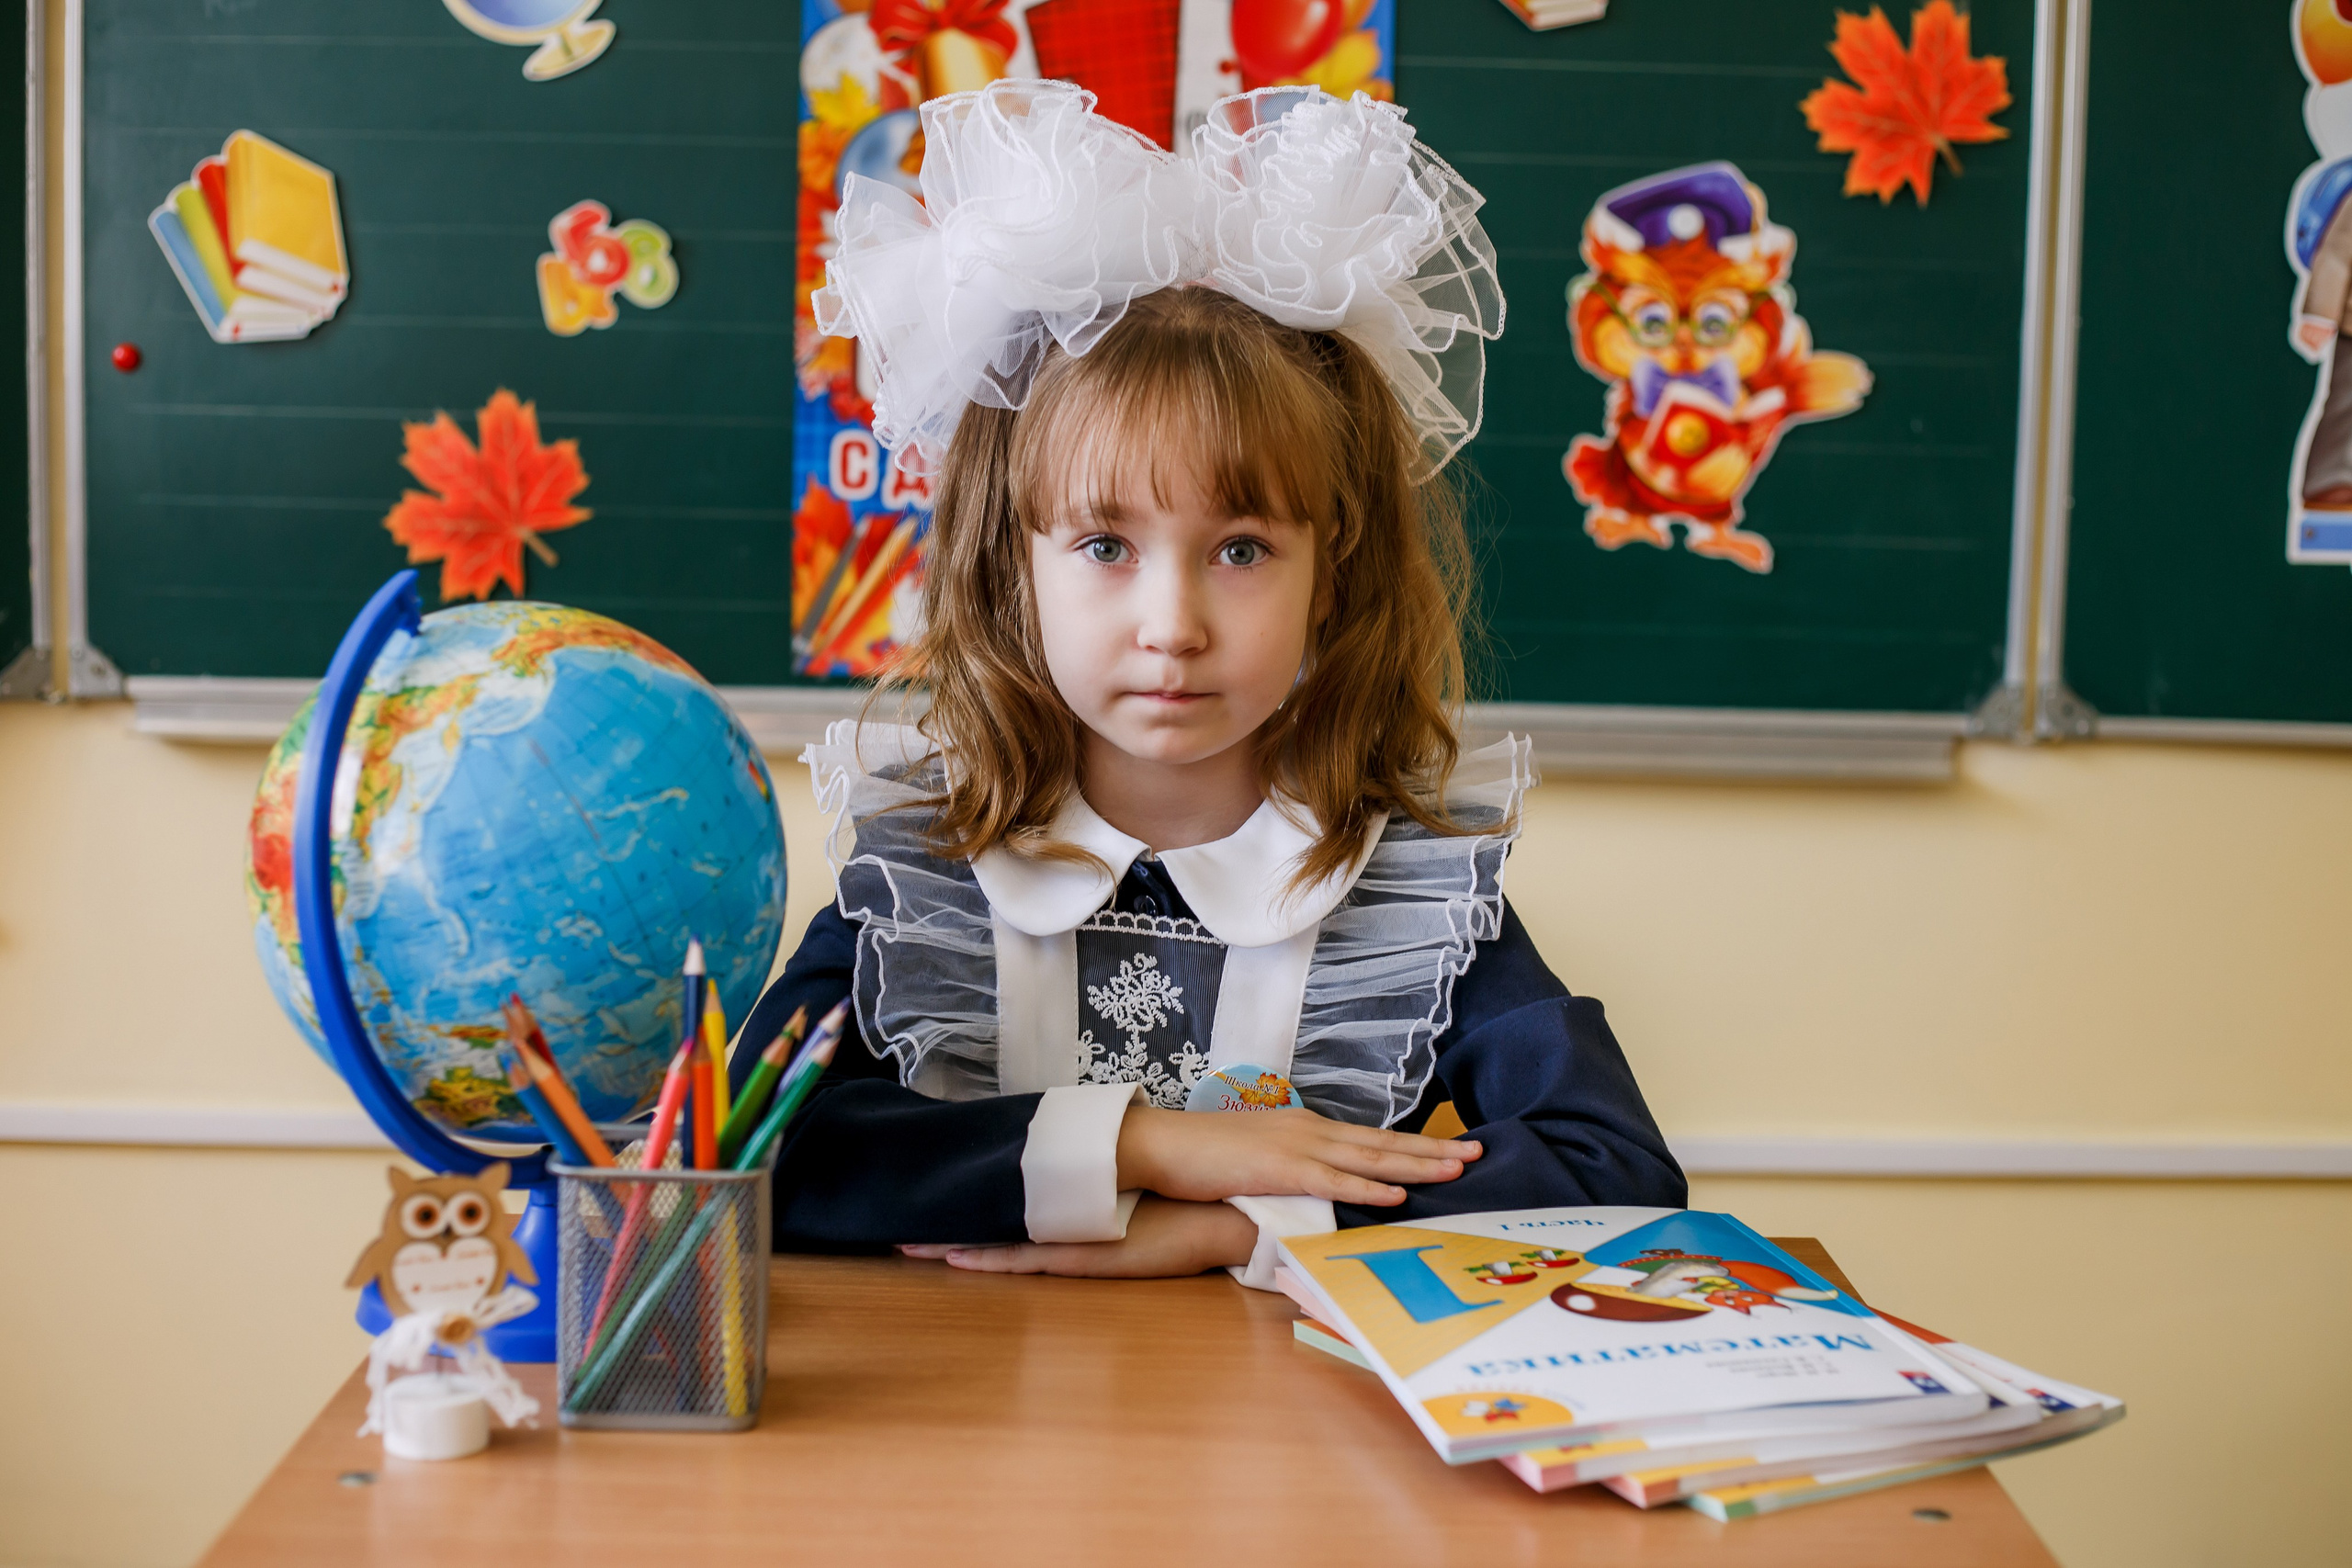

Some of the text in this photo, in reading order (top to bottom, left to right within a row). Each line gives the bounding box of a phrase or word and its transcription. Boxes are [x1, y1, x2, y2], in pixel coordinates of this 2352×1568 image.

[1225, 1076, 1260, 1091] Школа
[1518, 1219, 1606, 1228] Часть
[1325, 1245, 1504, 1324] 1
[1464, 1332, 1880, 1377] Математика
